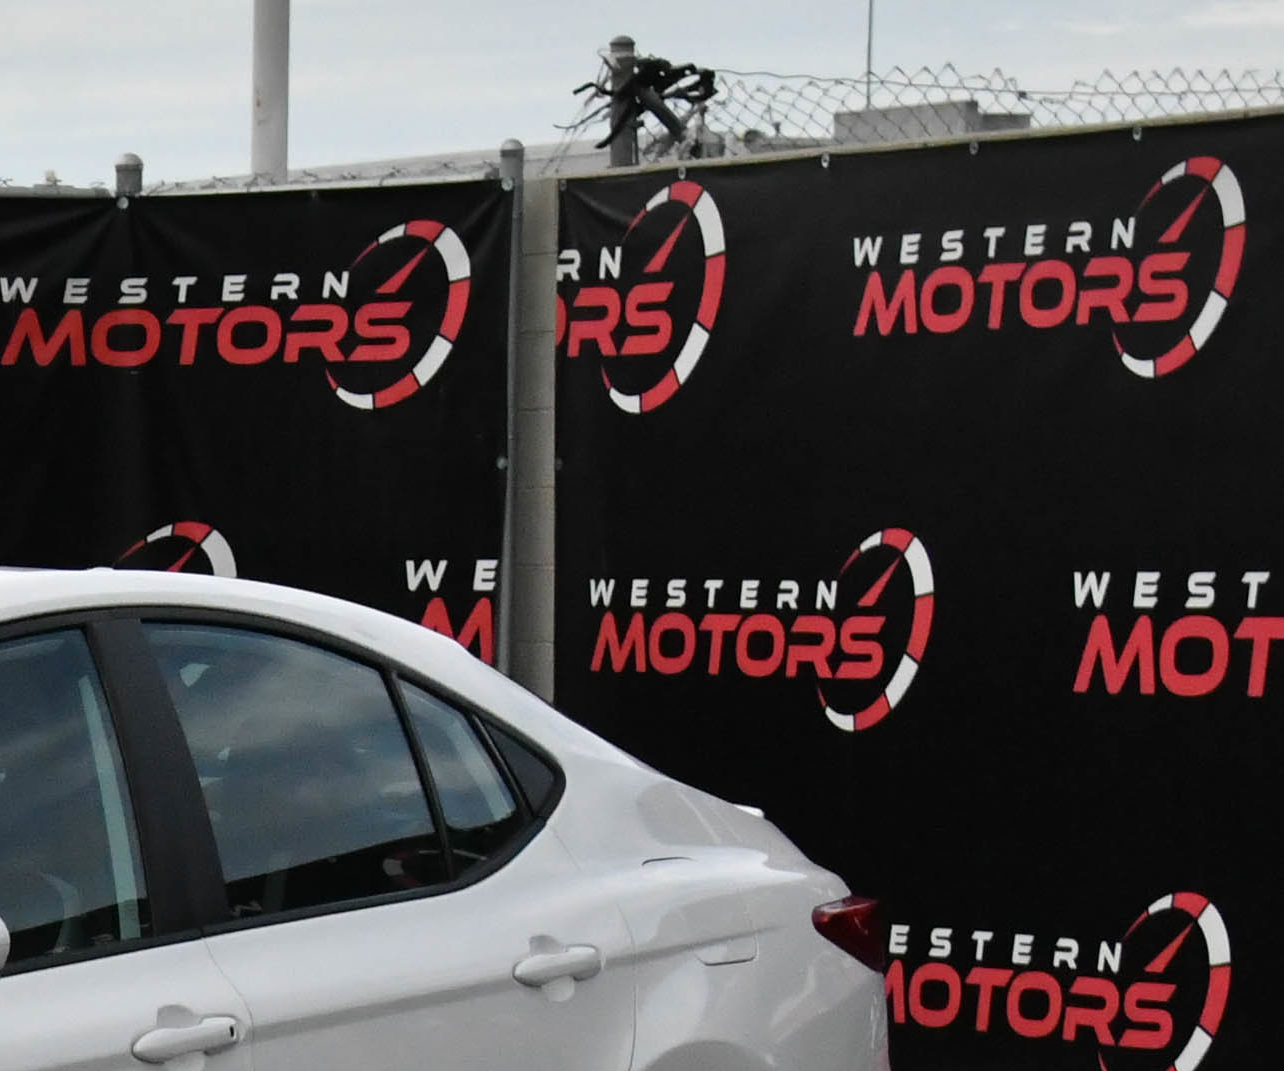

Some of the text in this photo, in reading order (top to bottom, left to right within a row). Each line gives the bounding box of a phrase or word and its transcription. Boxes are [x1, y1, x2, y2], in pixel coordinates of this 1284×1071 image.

[854, 216, 1136, 268] WESTERN
[0, 271, 350, 304] WESTERN
[854, 252, 1191, 336] MOTORS
[2, 301, 413, 367] MOTORS
[556, 281, 674, 358] RS
[406, 559, 498, 591] WE
[589, 578, 838, 610] WESTERN
[1073, 571, 1270, 609] WEST
[591, 612, 886, 679] MOTORS
